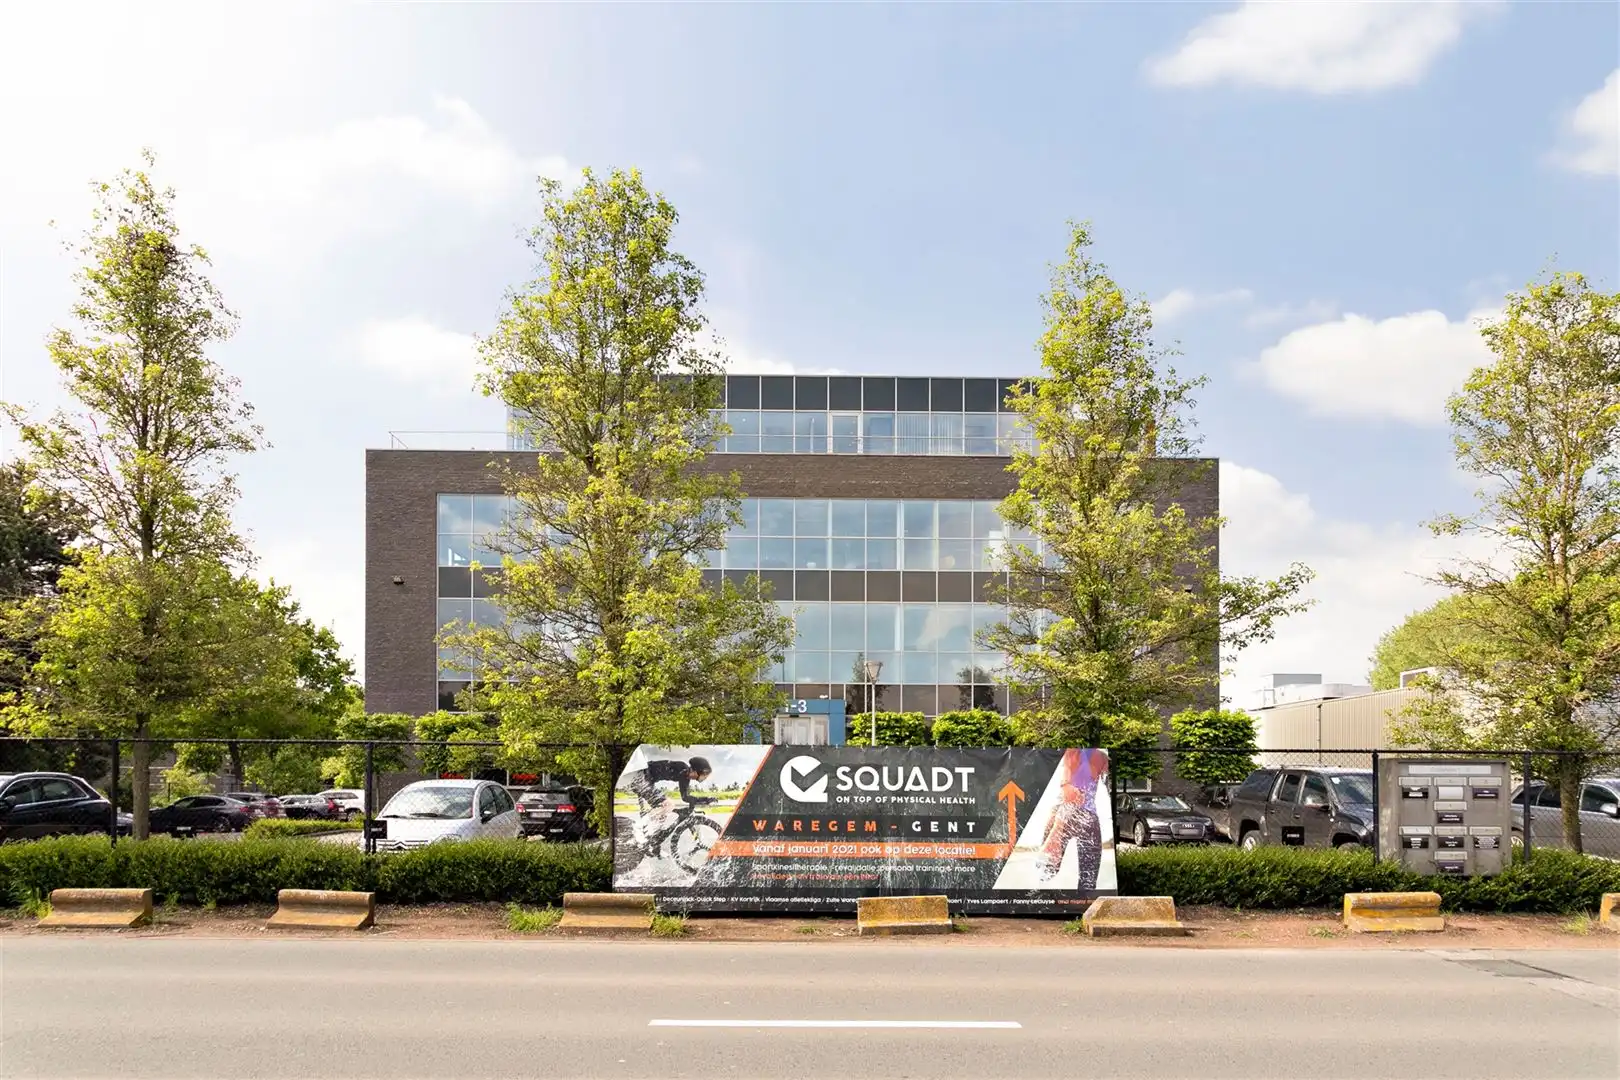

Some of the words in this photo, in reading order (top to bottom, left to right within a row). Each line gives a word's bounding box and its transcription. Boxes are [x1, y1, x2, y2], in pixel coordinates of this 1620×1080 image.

[836, 766, 975, 791] SQUADT
[875, 796, 888, 804] OF
[891, 796, 937, 804] PHYSICAL
[940, 796, 976, 804] HEALTH
[752, 820, 876, 832] WAREGEM
[911, 820, 976, 832] GENT
[788, 843, 828, 855] januari
[832, 844, 857, 854] 2021
[903, 844, 931, 855] deze
[935, 844, 976, 855] locatie!
[915, 864, 945, 874] training
[954, 866, 976, 874] more
[739, 896, 760, 904] Kortrijk
